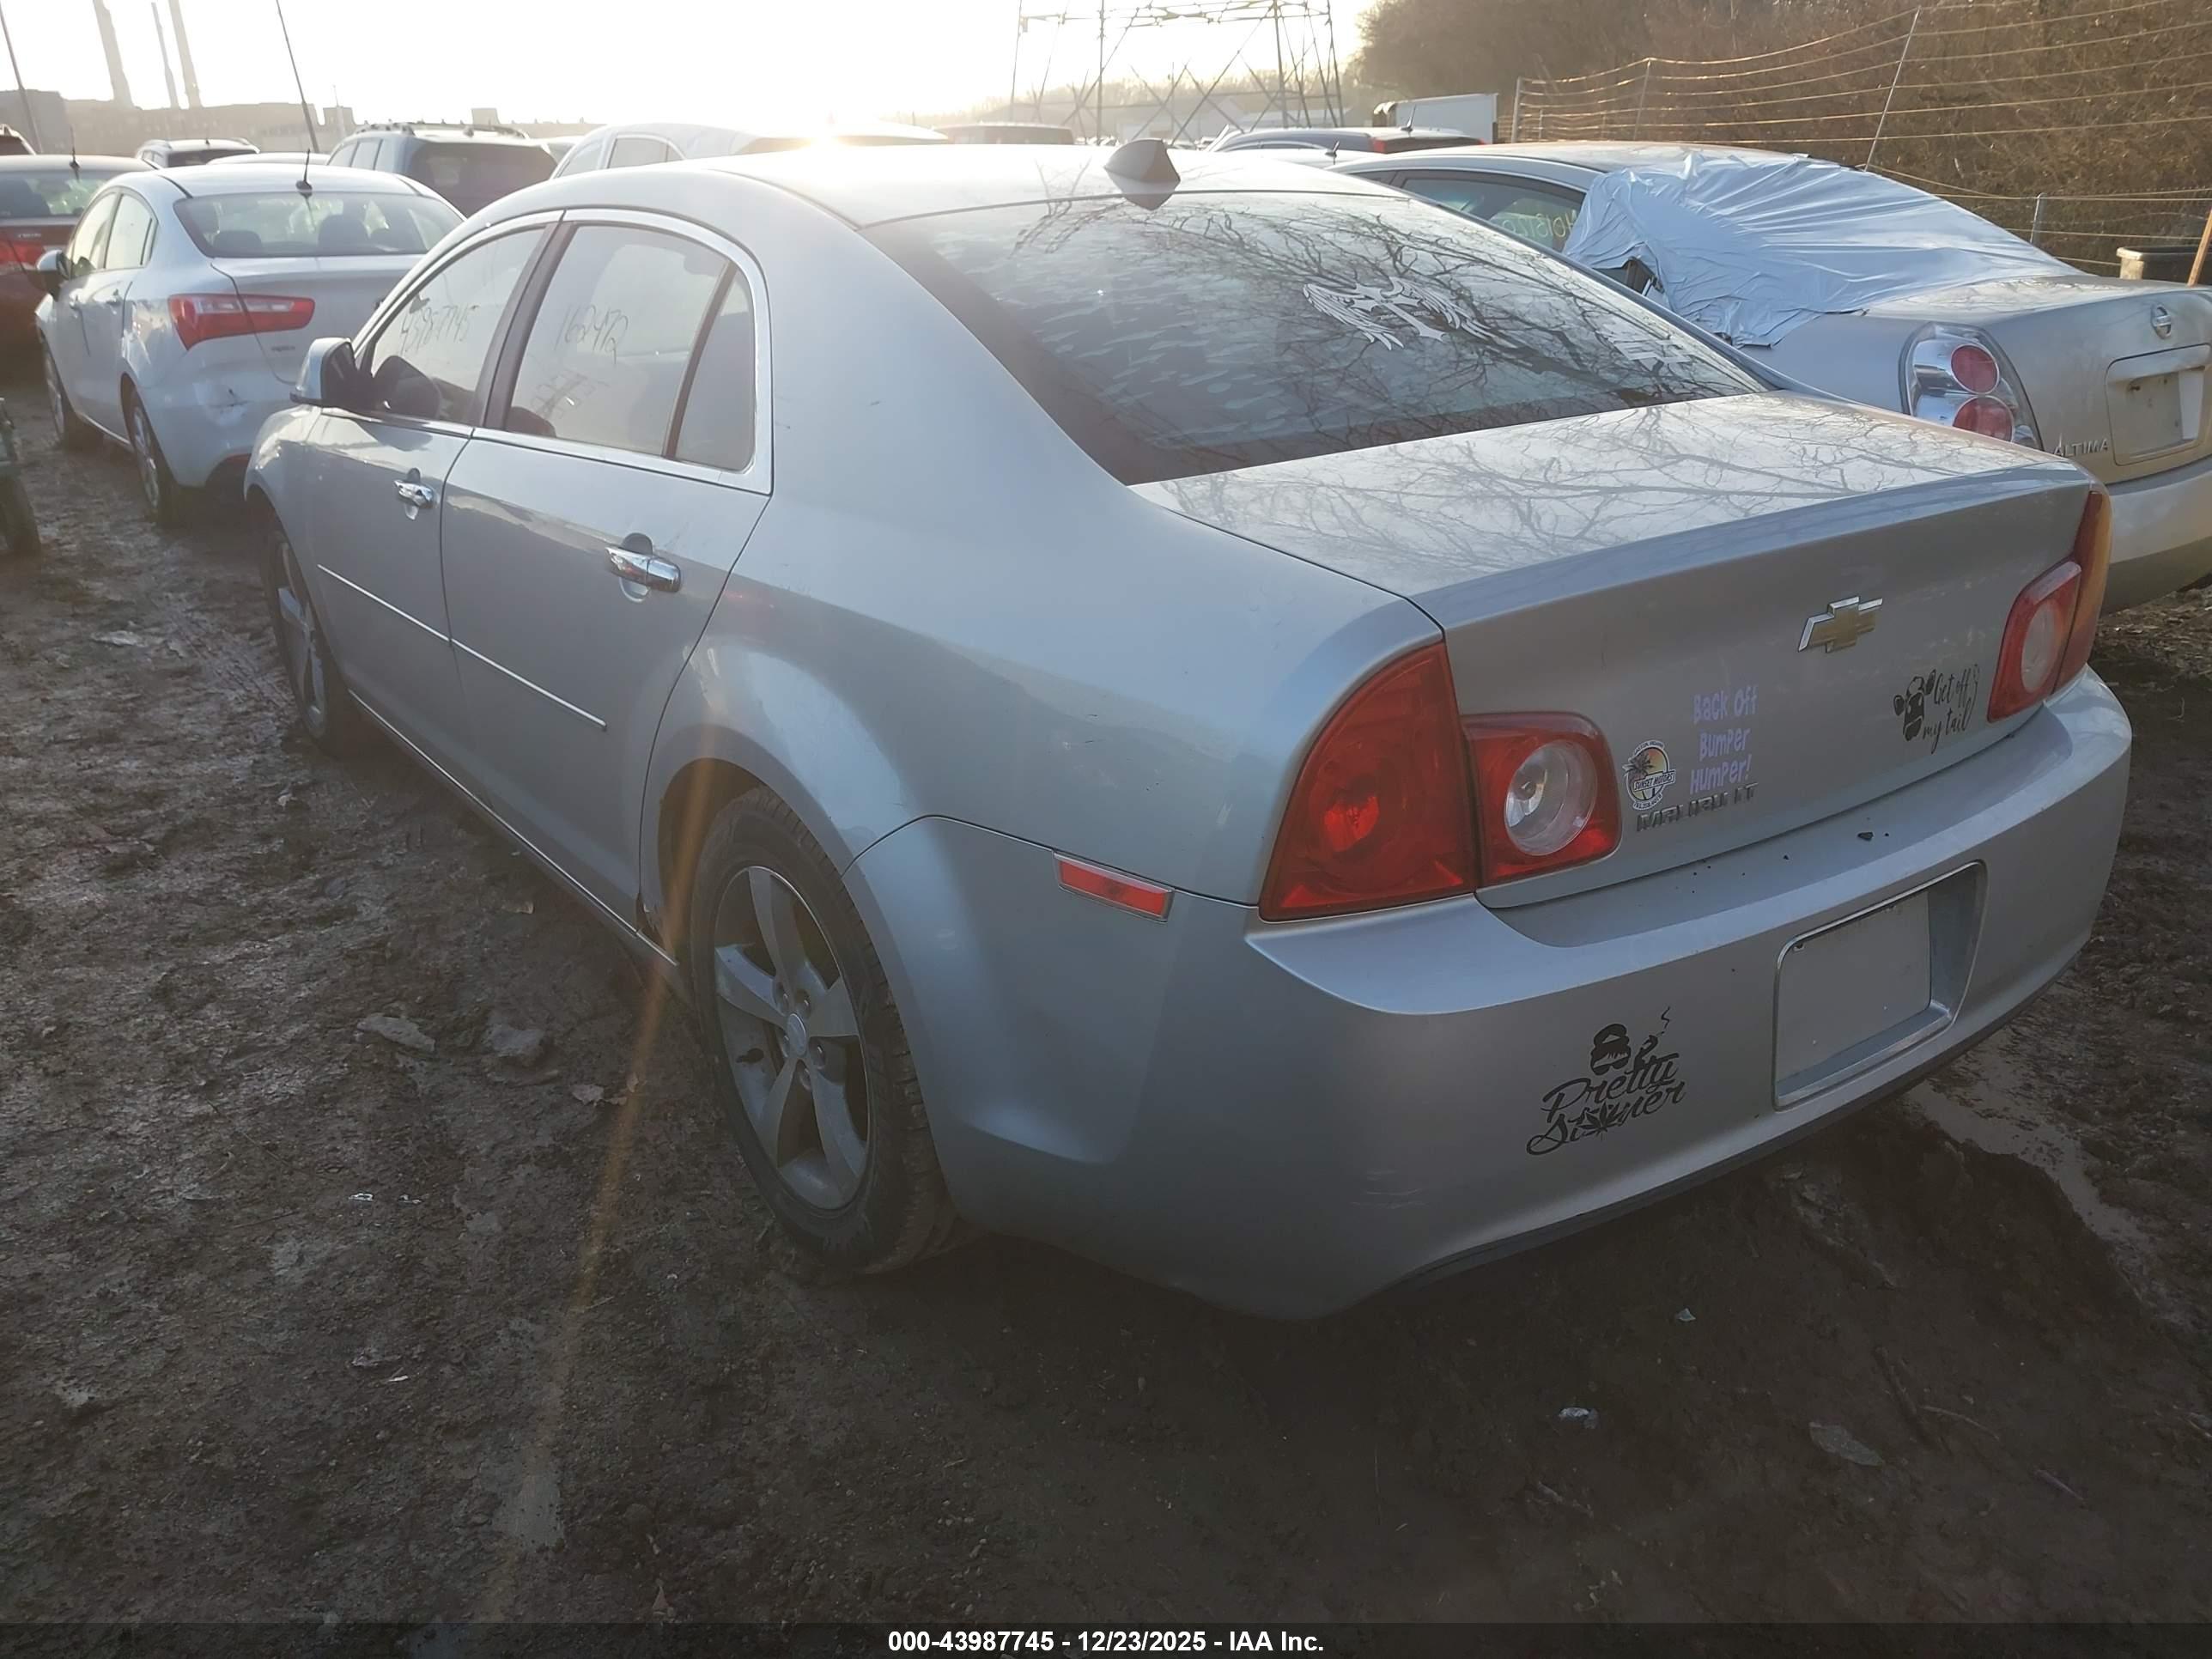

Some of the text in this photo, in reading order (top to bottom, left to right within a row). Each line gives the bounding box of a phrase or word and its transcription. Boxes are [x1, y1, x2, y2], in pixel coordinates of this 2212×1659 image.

[2053, 434, 2109, 457] ALTIMA
[1634, 772, 1674, 791] SUNSET MOTORS
[1540, 1052, 1680, 1123] Pretty
